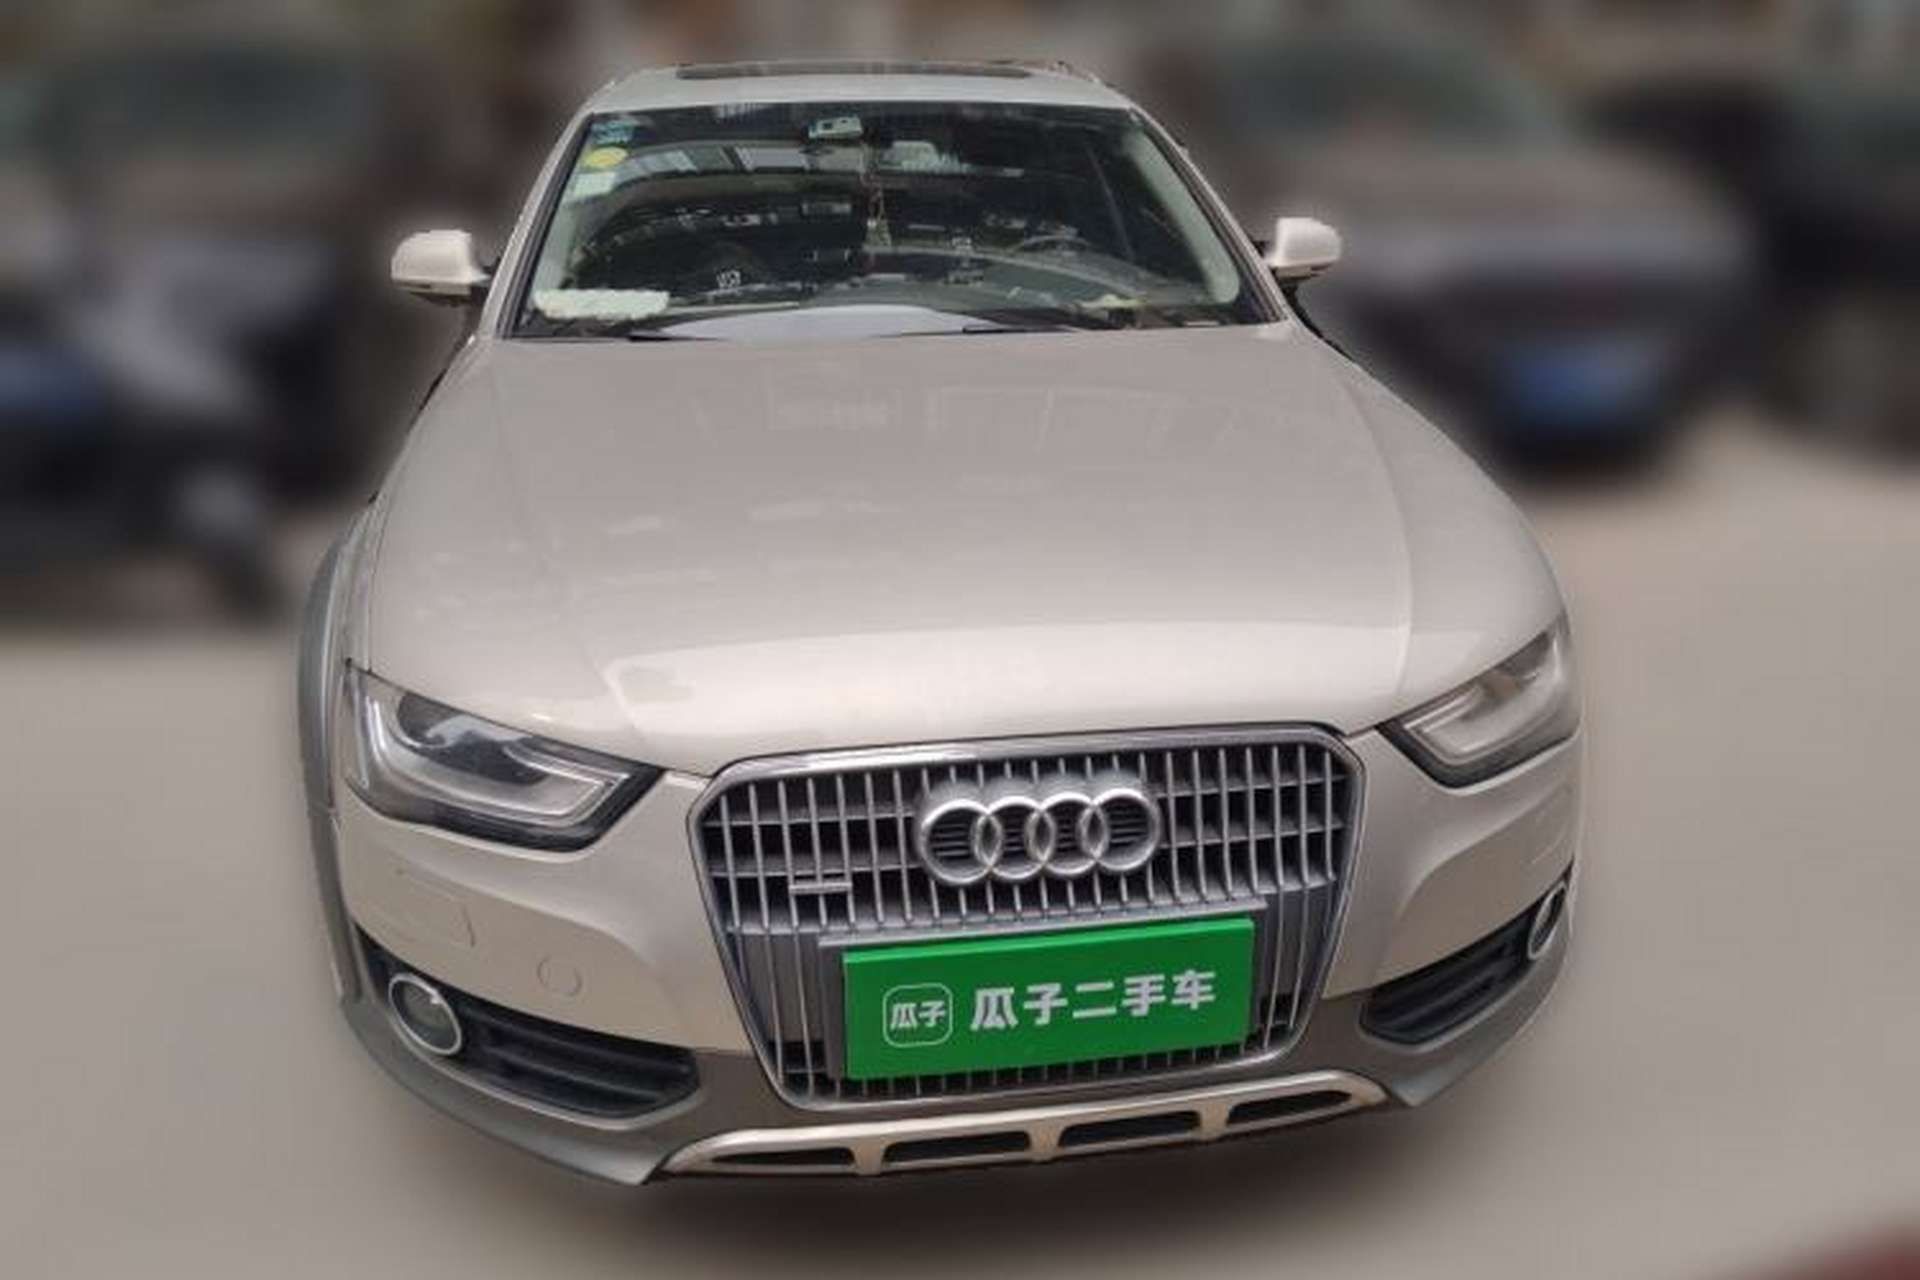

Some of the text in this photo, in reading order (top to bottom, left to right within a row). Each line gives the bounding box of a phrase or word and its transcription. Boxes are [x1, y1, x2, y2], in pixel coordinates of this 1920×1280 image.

[890, 1000, 947, 1031] 瓜子
[970, 969, 1216, 1031] 瓜子二手车
